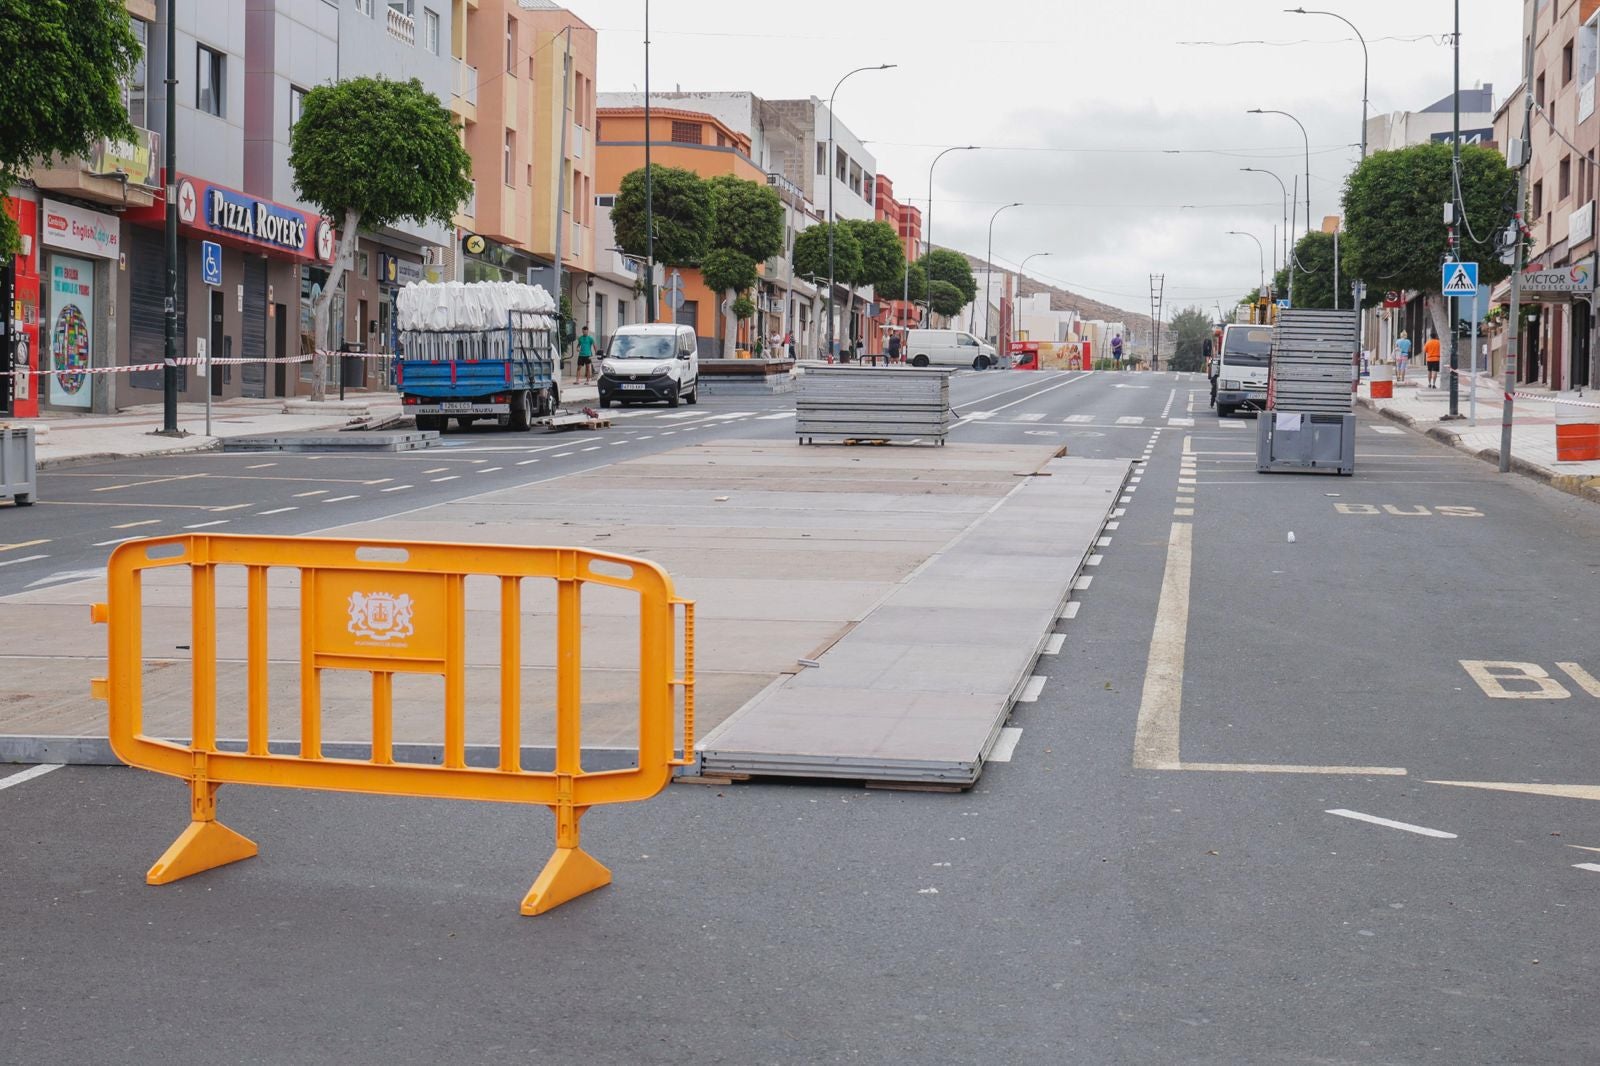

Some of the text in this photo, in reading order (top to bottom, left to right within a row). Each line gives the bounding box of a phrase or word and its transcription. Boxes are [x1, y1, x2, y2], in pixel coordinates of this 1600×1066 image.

[211, 189, 305, 249] PIZZA ROYER'S
[1333, 502, 1485, 517] BUS
